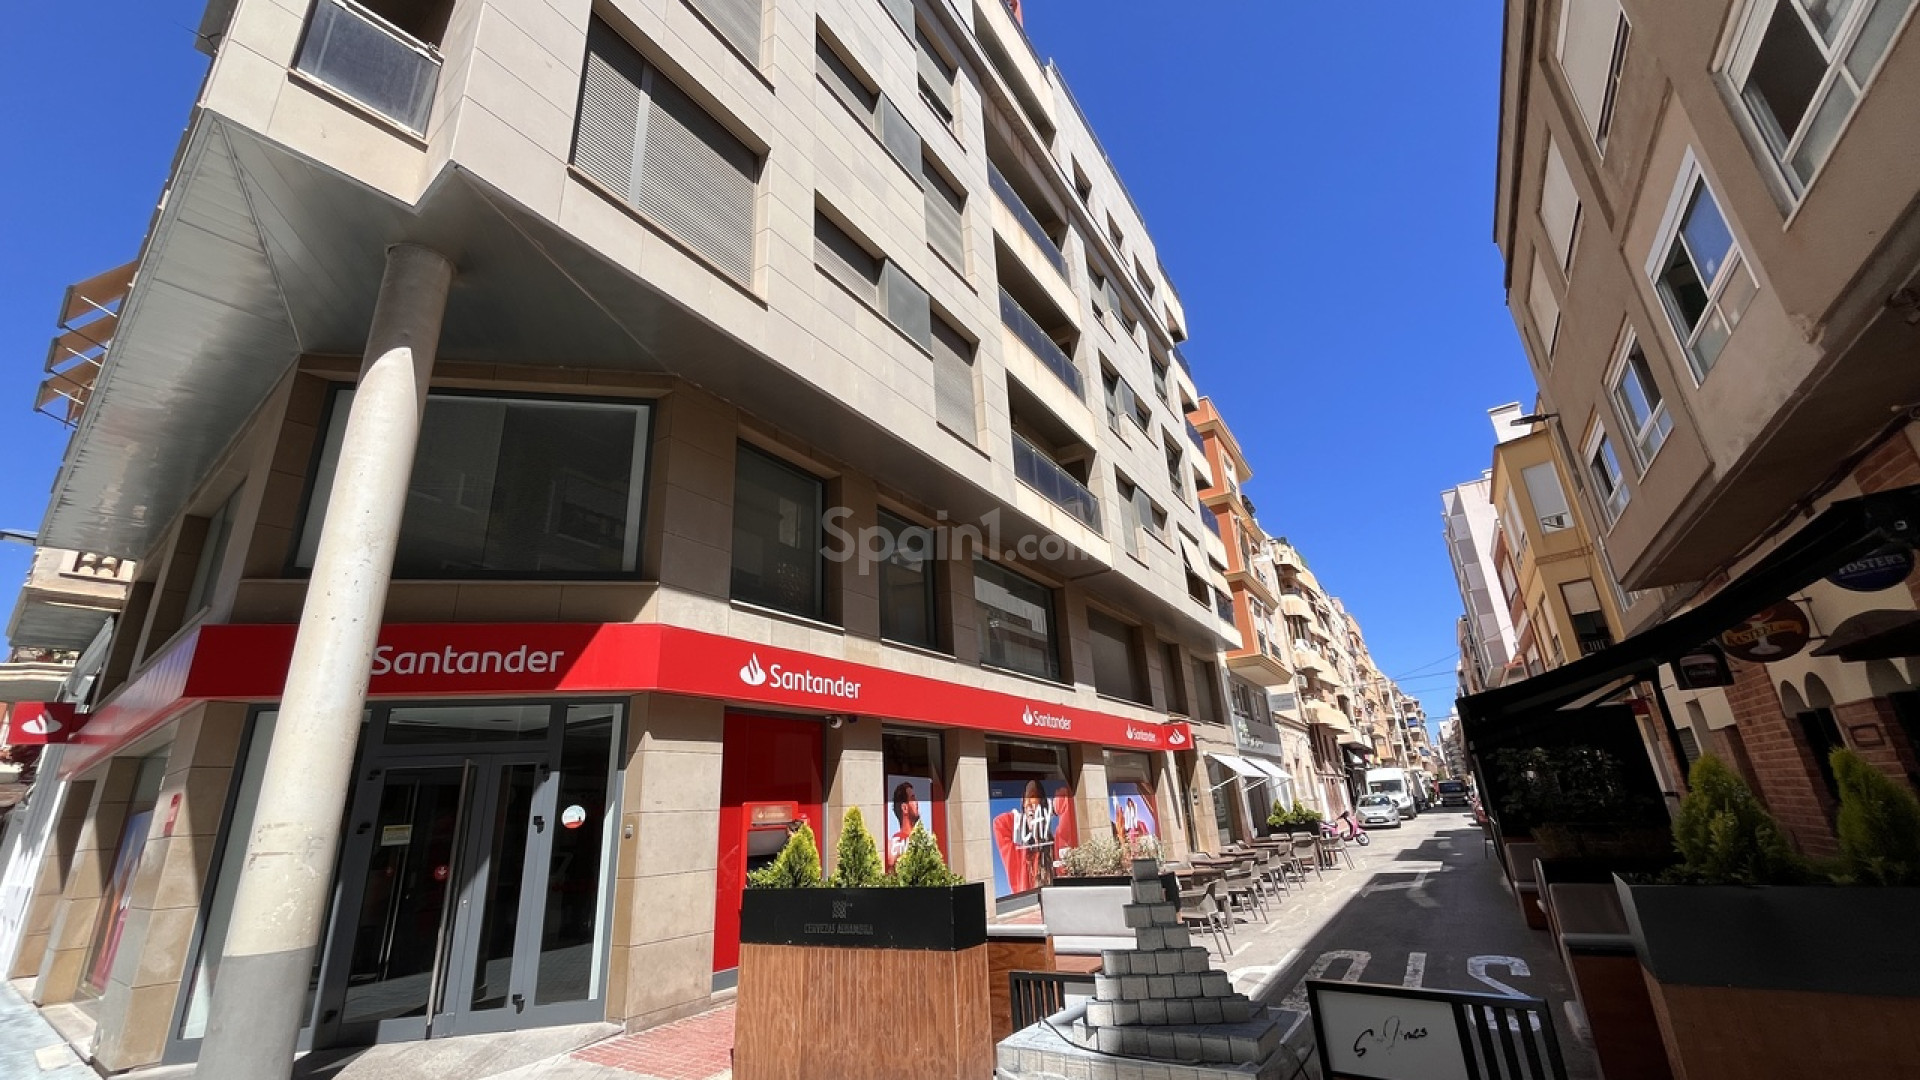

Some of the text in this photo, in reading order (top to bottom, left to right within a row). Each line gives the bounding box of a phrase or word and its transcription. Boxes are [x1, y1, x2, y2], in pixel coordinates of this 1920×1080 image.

[370, 644, 565, 676] Santander
[769, 663, 862, 699] Santander
[1033, 711, 1072, 731] Santander
[1132, 727, 1156, 743] Santander
[1012, 798, 1053, 844] PLAY
